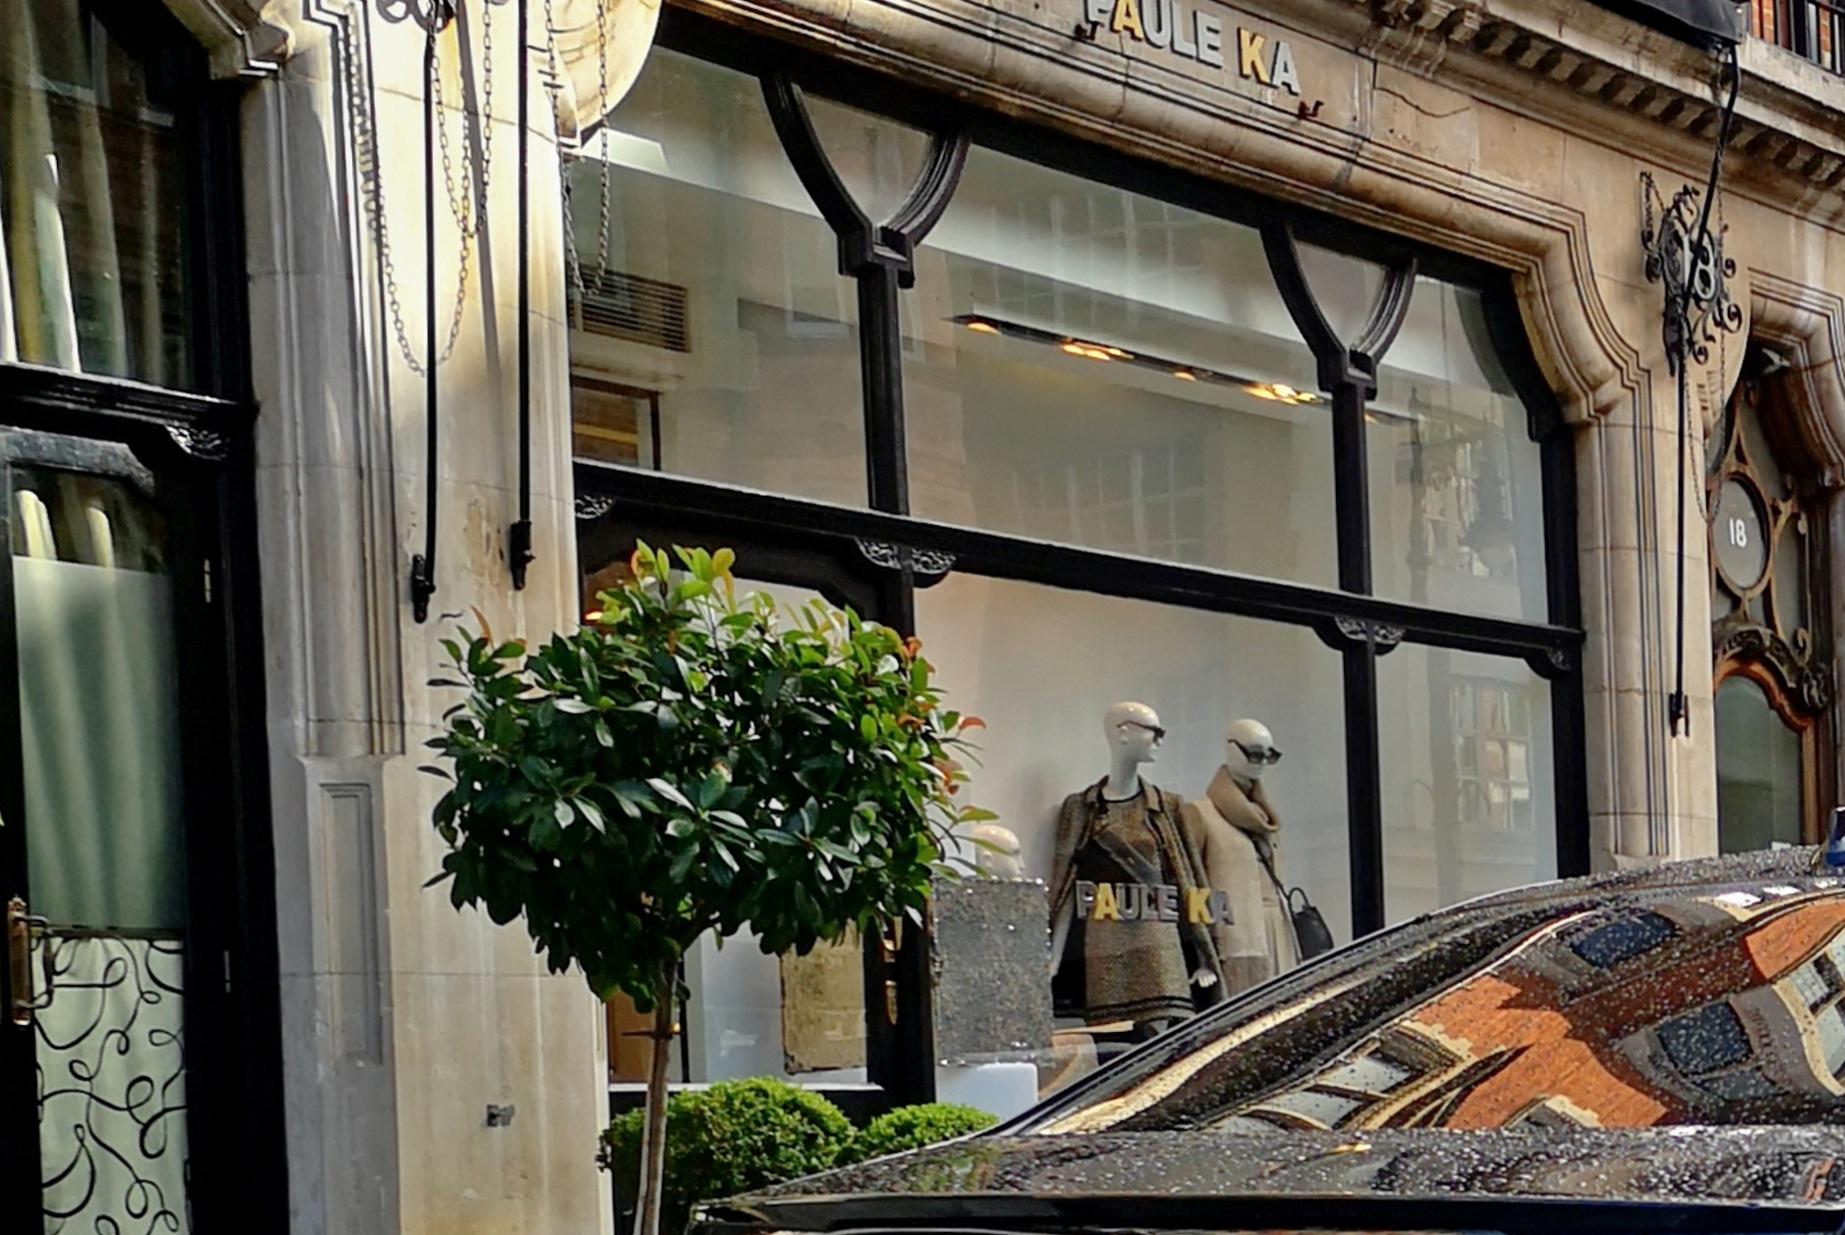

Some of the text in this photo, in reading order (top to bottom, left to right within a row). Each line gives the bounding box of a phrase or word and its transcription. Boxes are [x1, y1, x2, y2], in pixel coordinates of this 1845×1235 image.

[1237, 27, 1300, 96] KA
[1728, 516, 1748, 548] 18
[1076, 880, 1235, 926] PAULE KA
